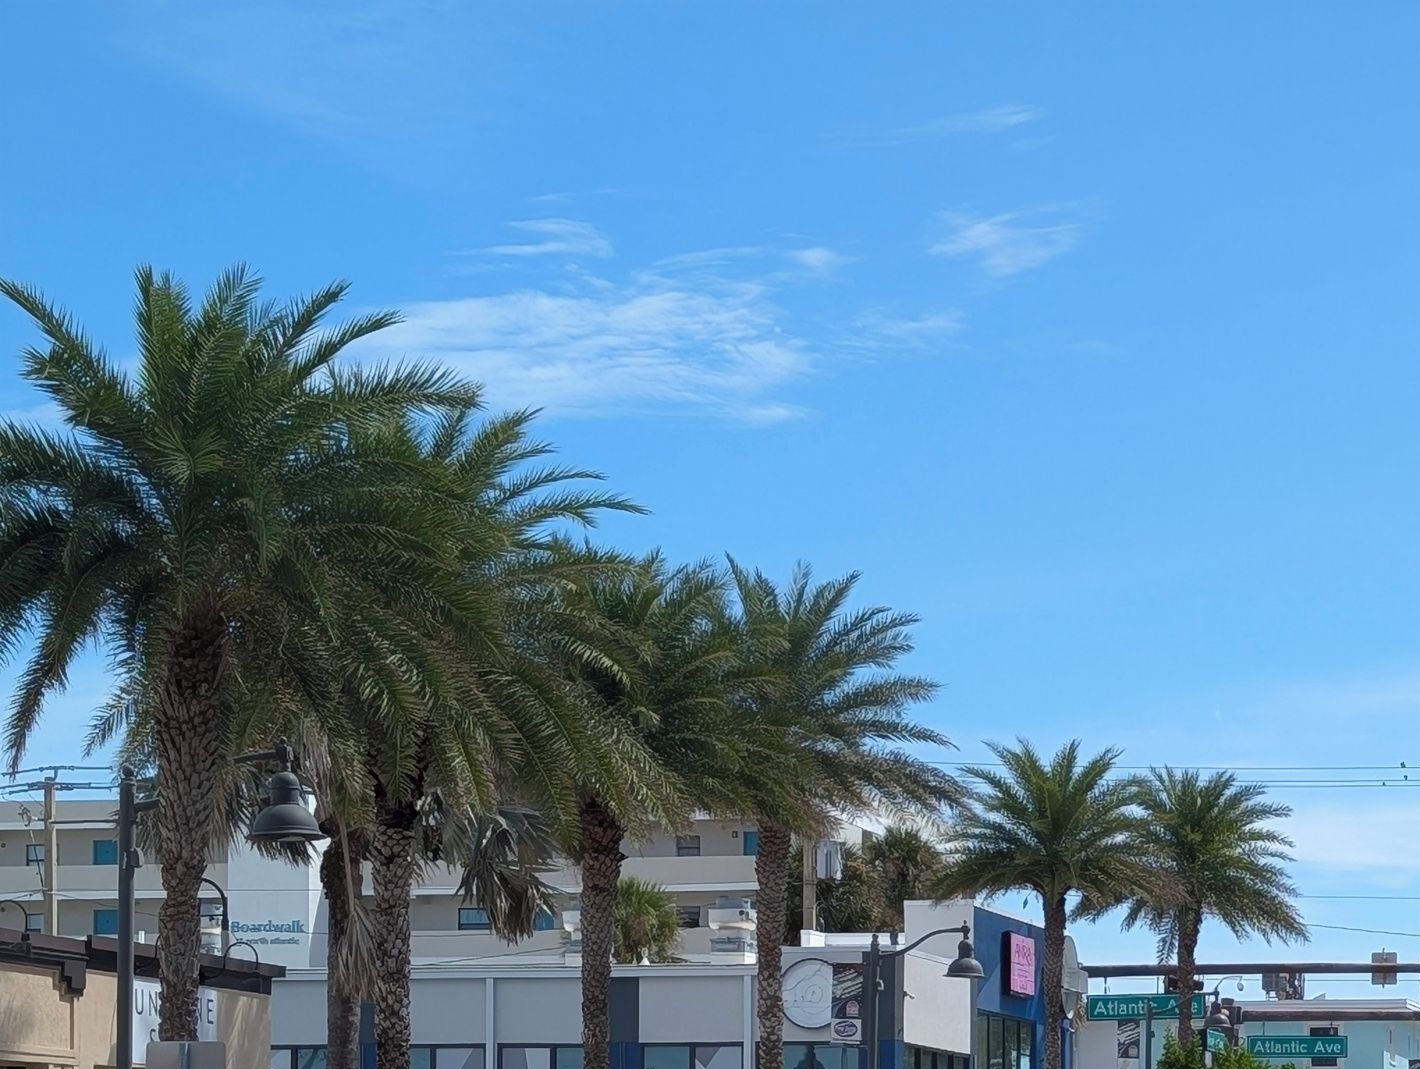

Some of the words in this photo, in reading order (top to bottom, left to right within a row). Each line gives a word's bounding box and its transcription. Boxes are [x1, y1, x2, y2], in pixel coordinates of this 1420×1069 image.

[231, 920, 304, 933] Boardwalk
[1094, 1000, 1158, 1016] Atlantic
[1167, 1000, 1198, 1014] Ae
[1254, 1041, 1308, 1054] Atlantic
[1314, 1042, 1341, 1053] Ave
